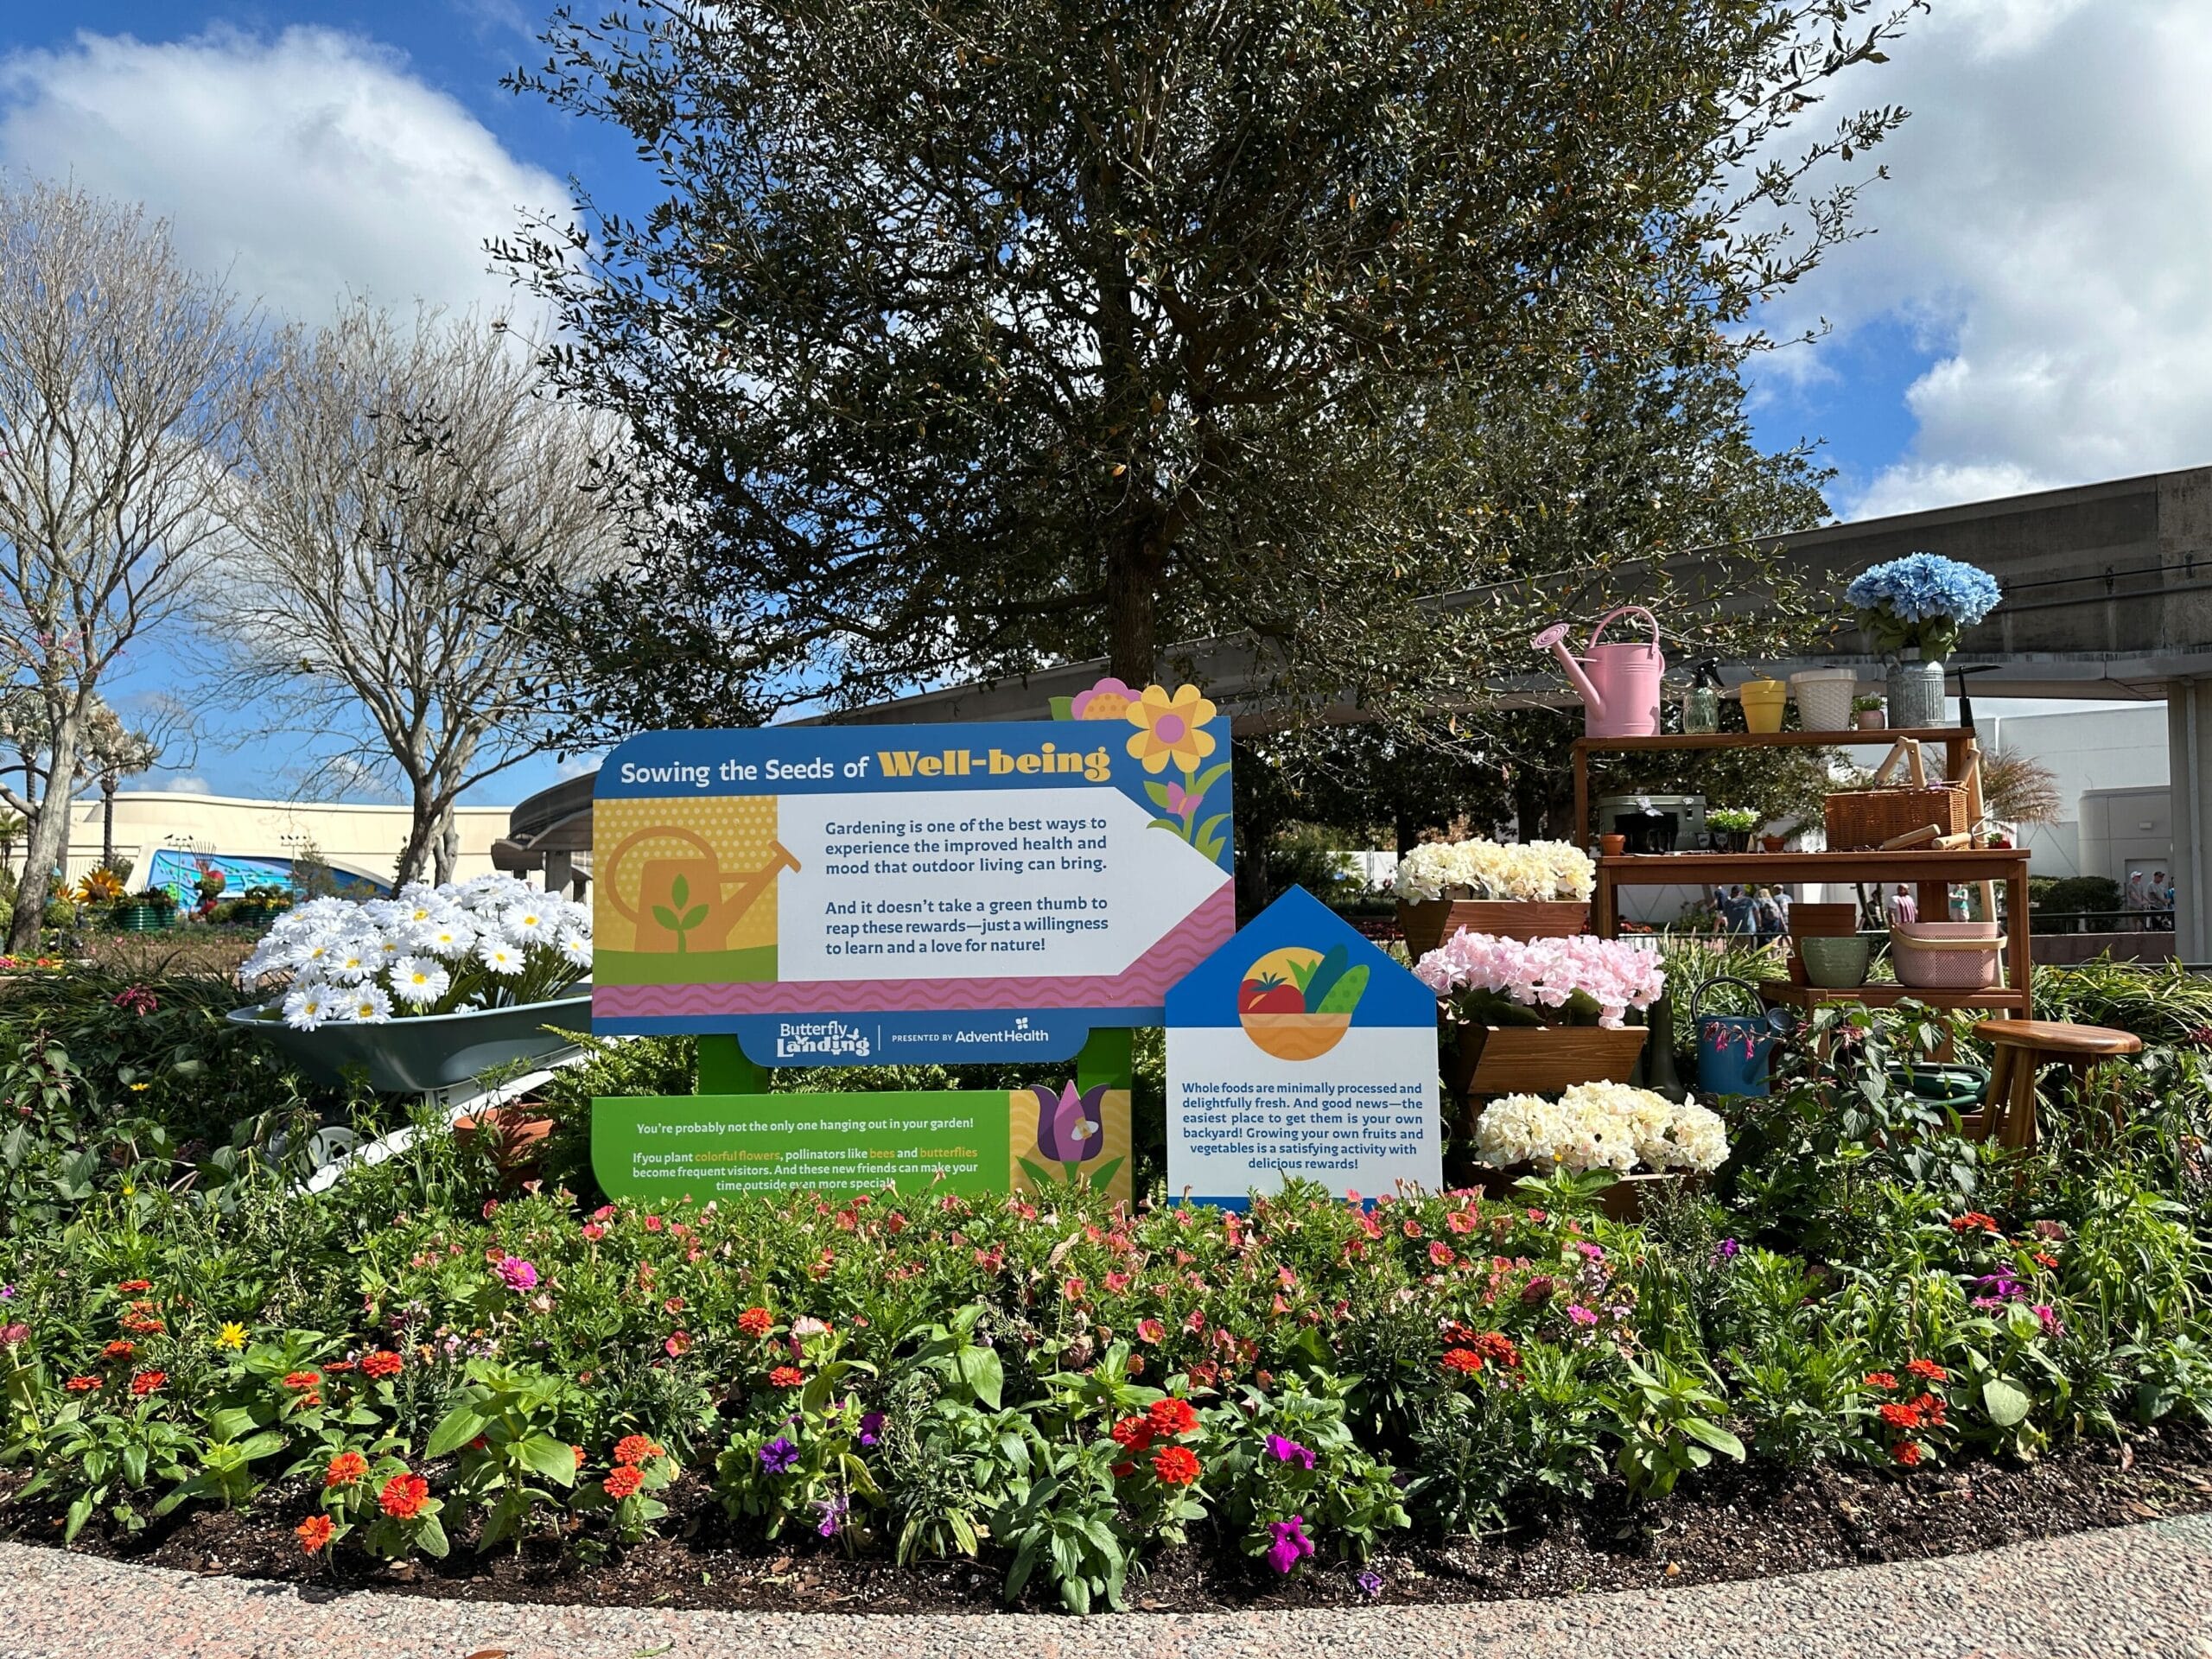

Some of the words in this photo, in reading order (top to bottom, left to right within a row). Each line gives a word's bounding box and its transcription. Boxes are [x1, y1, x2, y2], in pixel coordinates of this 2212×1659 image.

[621, 761, 710, 787] Sowing
[719, 760, 757, 781] the
[766, 757, 834, 779] Seeds
[843, 756, 869, 778] of
[877, 742, 1111, 782] Well-being
[825, 821, 906, 836] Gardening
[910, 820, 922, 833] is
[927, 823, 955, 832] one
[960, 818, 976, 832] of
[978, 818, 1004, 832] the
[1008, 817, 1042, 830] best
[1046, 820, 1086, 833] ways
[1090, 817, 1106, 829] to
[825, 841, 910, 858] experience
[913, 839, 939, 853] the
[944, 837, 1017, 855] improved
[1023, 836, 1072, 850] health
[1077, 836, 1106, 849] and
[826, 861, 869, 874] mood
[874, 860, 907, 874] that
[912, 859, 975, 873] outdoor
[980, 858, 1023, 874] living
[1028, 861, 1055, 870] can
[1061, 856, 1107, 873] bring.
[825, 900, 856, 914] And
[861, 900, 873, 913] it
[938, 899, 971, 912] take
[976, 902, 984, 912] a
[989, 901, 1032, 915] green
[1037, 896, 1087, 910] thumb
[1091, 898, 1107, 909] to
[826, 925, 860, 938] reap
[862, 920, 903, 934] these
[1013, 921, 1020, 931] a
[1024, 916, 1109, 933] willingness
[825, 944, 842, 955] to
[845, 941, 883, 954] learn
[887, 939, 915, 953] and
[919, 944, 927, 953] a
[931, 939, 962, 952] love
[965, 938, 987, 951] for
[991, 938, 1045, 951] nature!
[780, 1020, 848, 1038] Butterfly
[942, 1033, 953, 1042] BY
[777, 1033, 870, 1058] Landing
[1182, 1083, 1219, 1093] Whole
[1222, 1083, 1254, 1093] foods
[1277, 1082, 1335, 1096] minimally
[1338, 1083, 1397, 1096] processed
[1400, 1083, 1421, 1094] and
[1183, 1096, 1252, 1111] delightfully
[1255, 1097, 1290, 1108] fresh.
[1294, 1097, 1318, 1108] And
[1322, 1097, 1351, 1111] good
[676, 1122, 726, 1135] probably
[728, 1122, 747, 1132] not
[749, 1121, 768, 1131] the
[770, 1120, 795, 1134] only
[820, 1119, 867, 1132] hanging
[868, 1120, 887, 1129] out
[890, 1118, 900, 1128] in
[902, 1121, 928, 1131] your
[931, 1117, 973, 1131] garden!
[1183, 1112, 1227, 1123] easiest
[1231, 1112, 1264, 1126] place
[1268, 1114, 1281, 1123] to
[1286, 1114, 1306, 1126] get
[1310, 1113, 1342, 1123] them
[1348, 1113, 1358, 1123] is
[1362, 1116, 1391, 1127] your
[1184, 1127, 1243, 1141] backyard!
[1247, 1128, 1299, 1141] Growing
[1301, 1130, 1329, 1141] your
[1332, 1130, 1359, 1139] own
[1363, 1128, 1396, 1139] fruits
[1401, 1128, 1423, 1139] and
[642, 1155, 662, 1166] you
[664, 1152, 693, 1165] plant
[695, 1151, 737, 1161] colorful
[739, 1150, 784, 1162] flowers,
[785, 1148, 846, 1162] pollinators
[848, 1147, 868, 1159] like
[870, 1148, 895, 1158] bees
[897, 1147, 918, 1158] and
[920, 1147, 977, 1158] butterflies
[1191, 1142, 1254, 1156] vegetables
[1257, 1142, 1267, 1154] is
[1279, 1142, 1338, 1156] satisfying
[1341, 1143, 1386, 1157] activity
[1389, 1143, 1416, 1154] with
[633, 1165, 676, 1178] become
[677, 1166, 726, 1179] frequent
[728, 1165, 772, 1175] visitors.
[774, 1164, 797, 1174] And
[798, 1164, 830, 1174] these
[857, 1162, 897, 1173] friends
[921, 1161, 951, 1173] make
[952, 1164, 978, 1175] your
[1249, 1158, 1302, 1169] delicious
[1305, 1158, 1358, 1169] rewards!
[716, 1180, 741, 1191] time
[745, 1179, 787, 1191] outside
[818, 1179, 848, 1190] more
